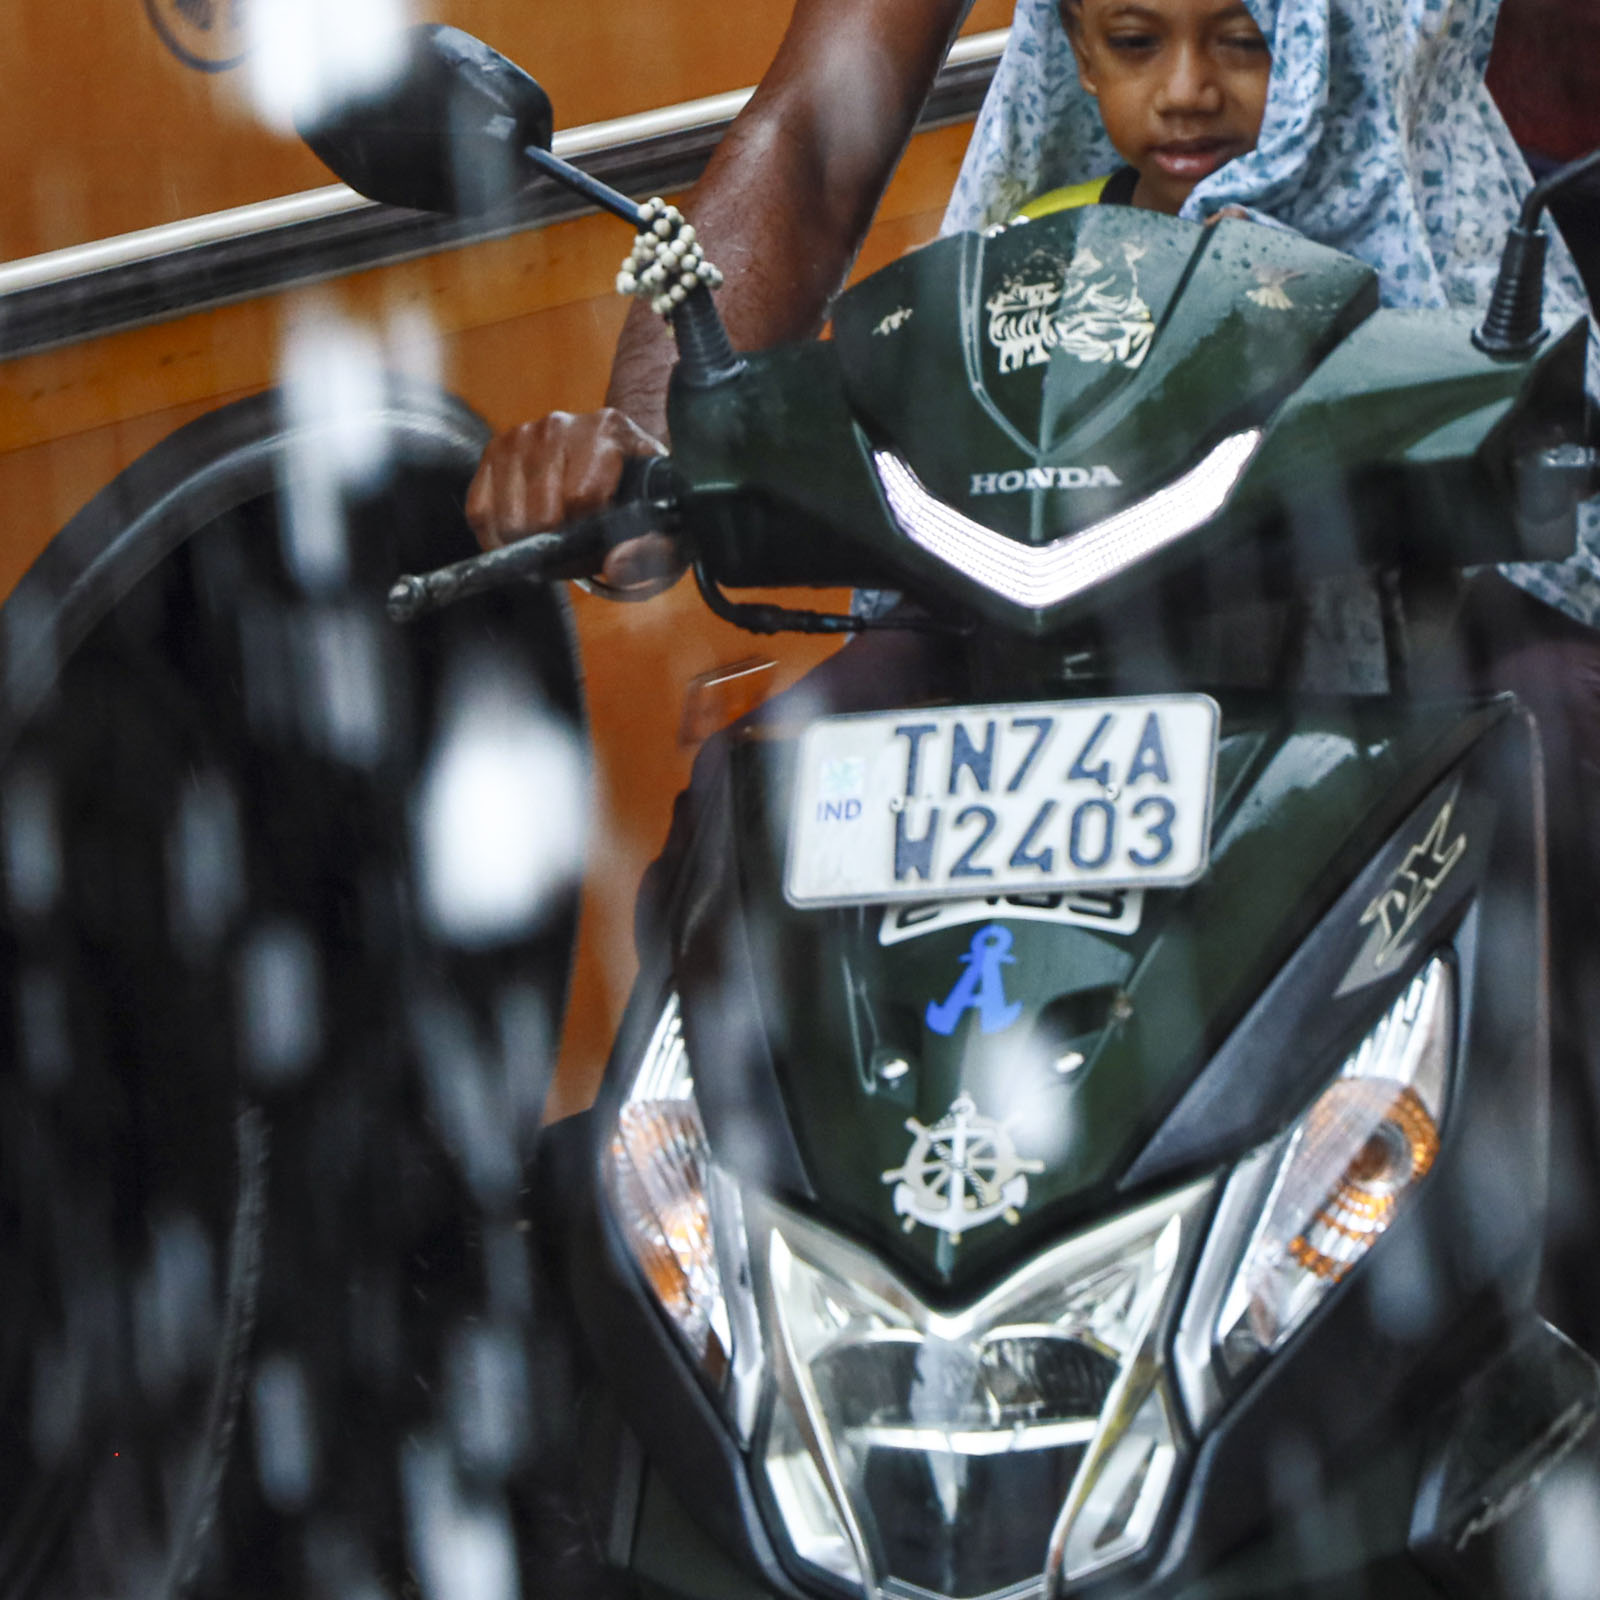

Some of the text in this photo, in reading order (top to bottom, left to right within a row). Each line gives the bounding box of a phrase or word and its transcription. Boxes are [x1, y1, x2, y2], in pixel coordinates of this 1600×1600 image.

[970, 464, 1121, 495] HONDA
[895, 711, 1171, 799] TN74A
[816, 799, 862, 823] IND
[894, 796, 1178, 883] W2403
